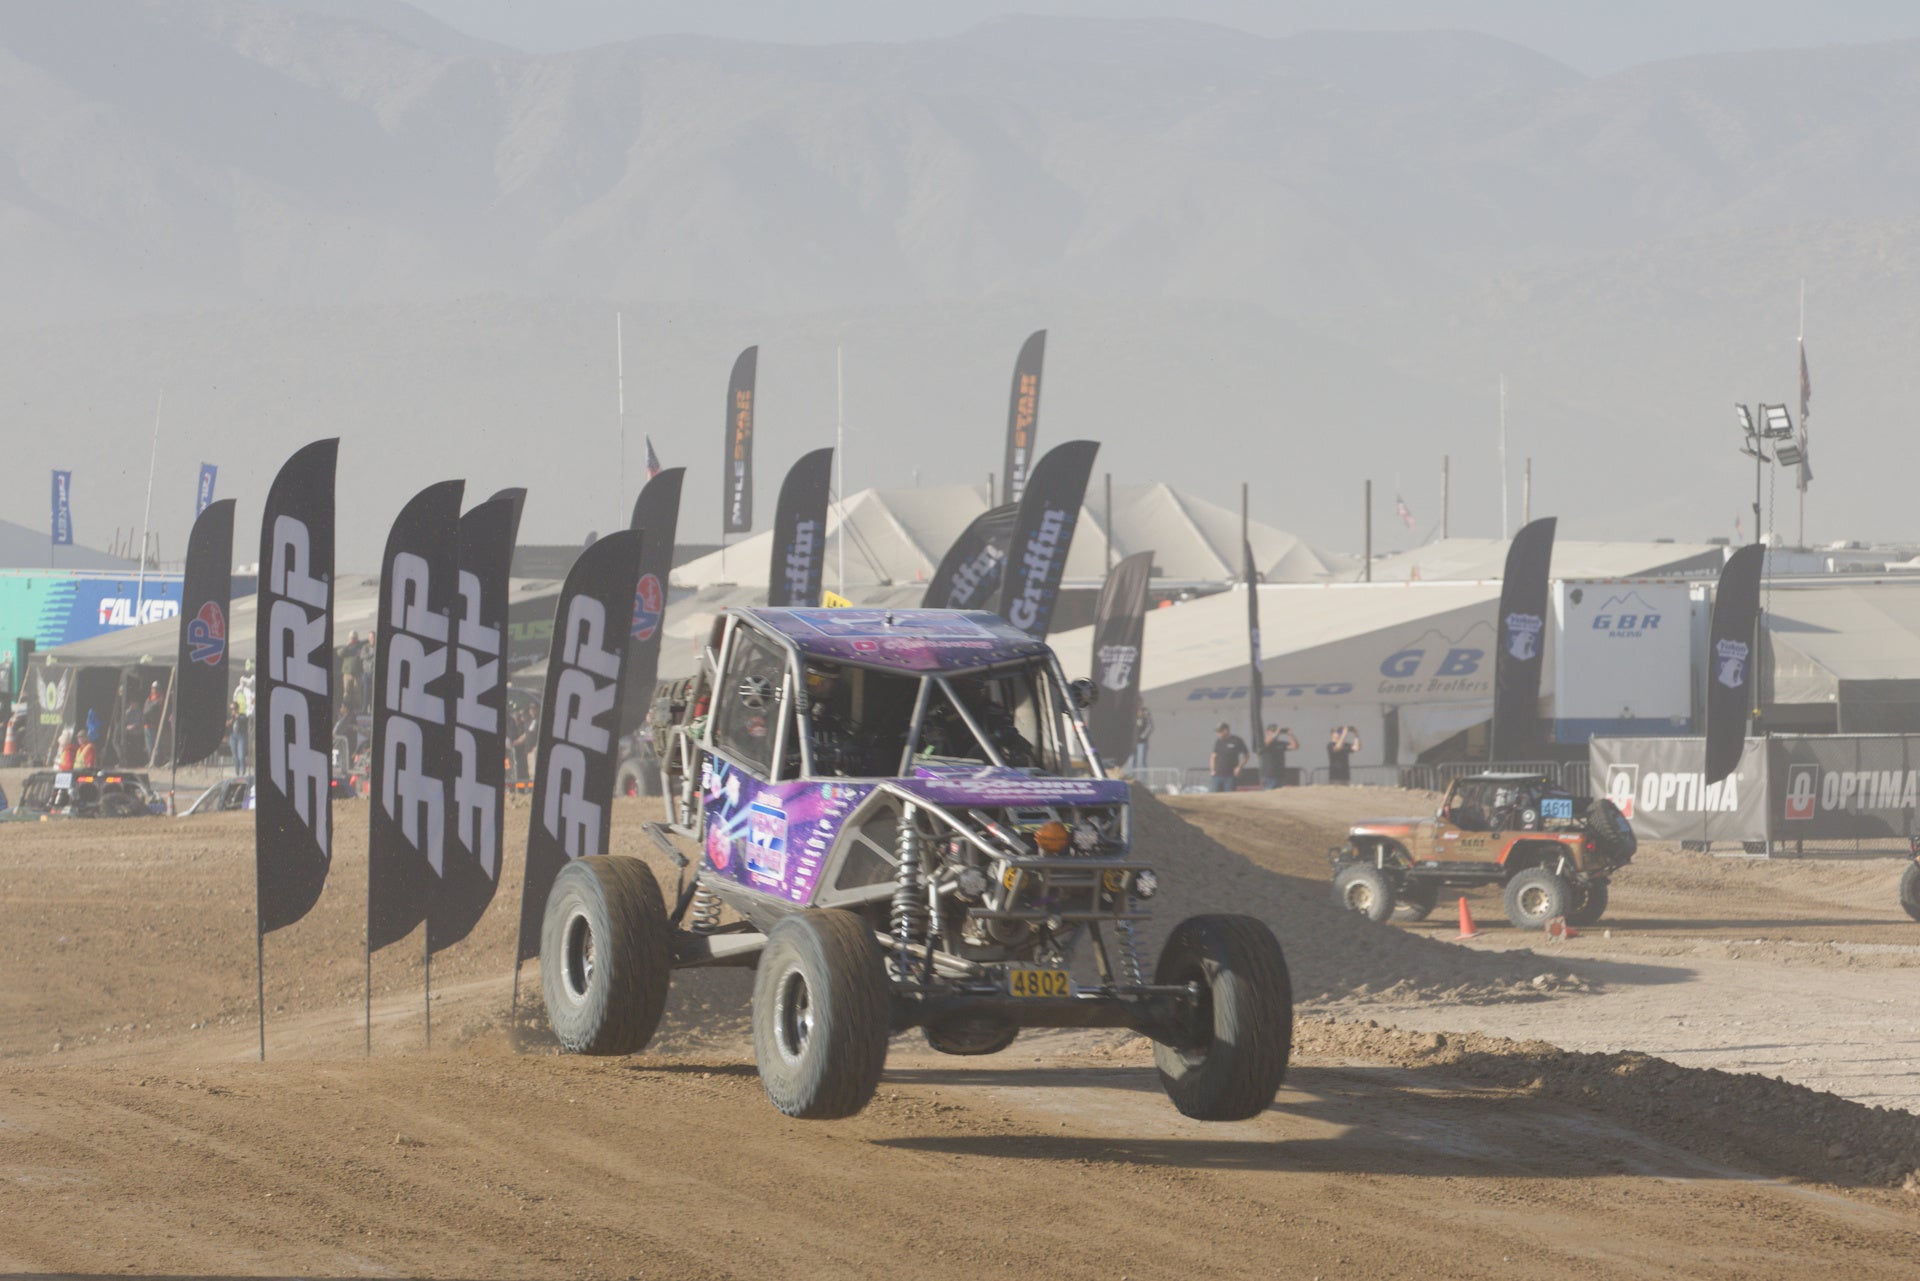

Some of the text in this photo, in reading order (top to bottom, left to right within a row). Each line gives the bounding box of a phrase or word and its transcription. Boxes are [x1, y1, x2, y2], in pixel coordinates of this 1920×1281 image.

[731, 389, 749, 527] MILESTAR
[785, 519, 815, 607] riffin
[1009, 508, 1065, 631] Griffin
[98, 598, 179, 626] FALKEN
[187, 618, 226, 663] VP
[1608, 631, 1643, 639] RACING
[268, 514, 330, 859] PRP
[382, 551, 450, 879] PRP
[1543, 801, 1571, 817] 4611
[1641, 772, 1739, 812] OPTIMA
[1821, 769, 1916, 811] OPTIMA
[1012, 971, 1069, 995] 4802
